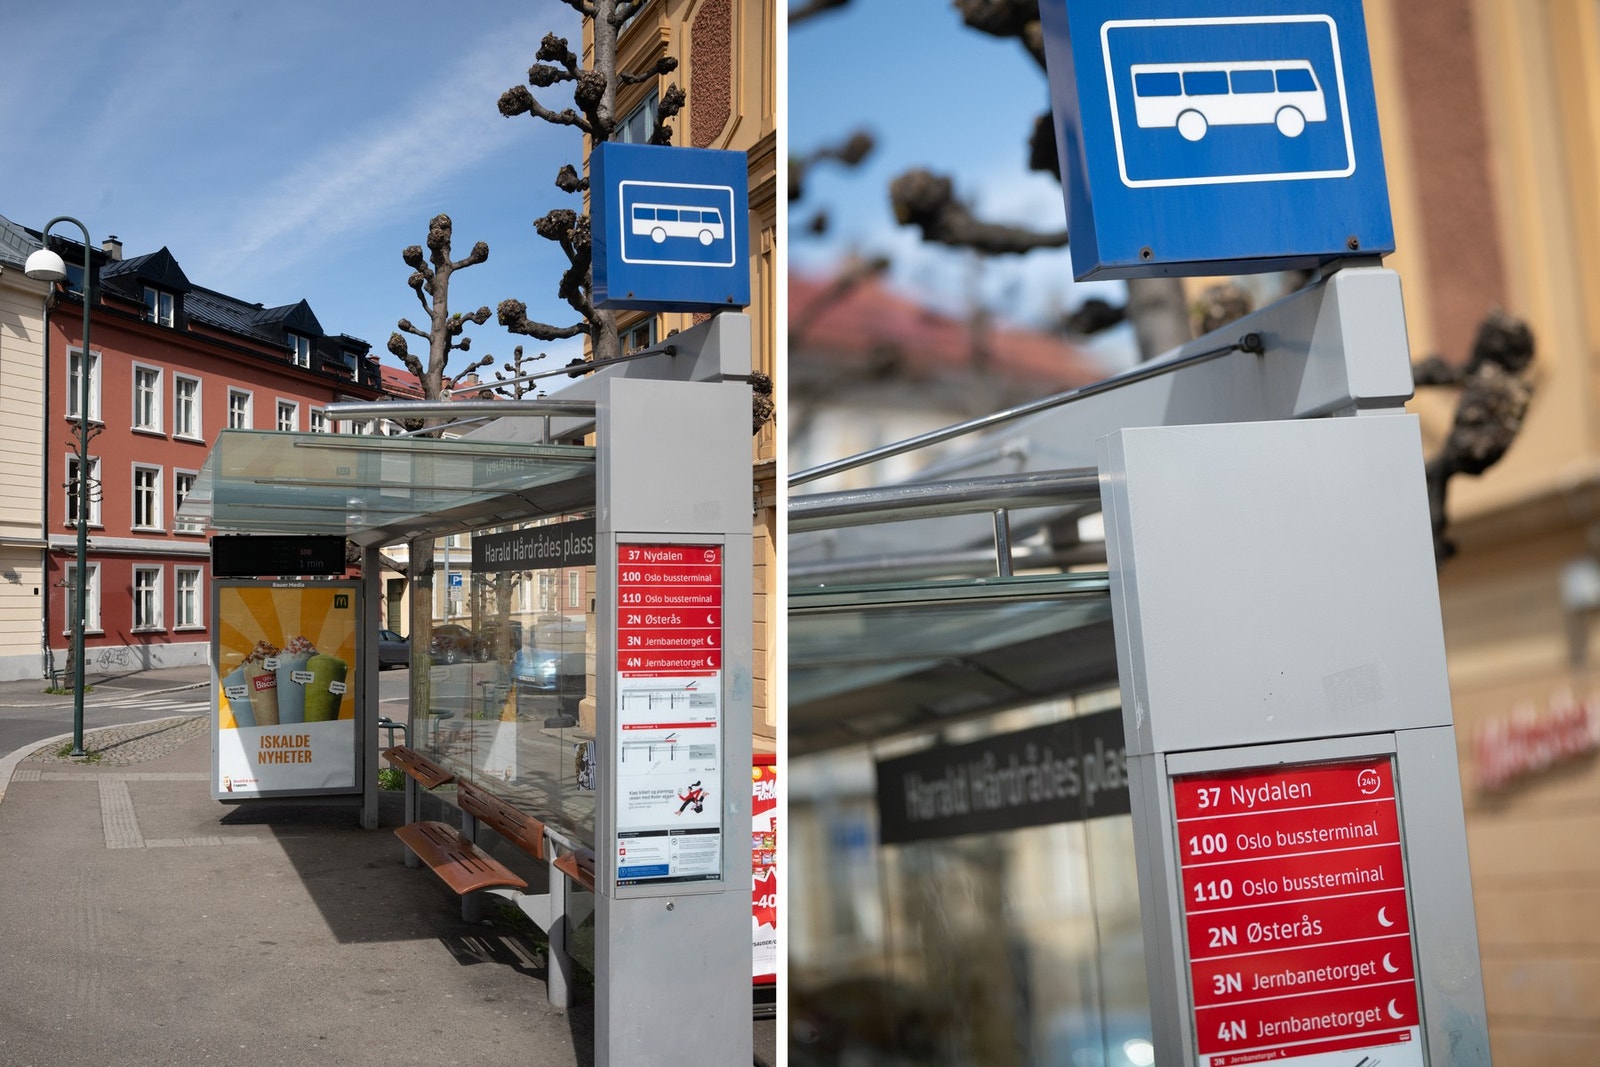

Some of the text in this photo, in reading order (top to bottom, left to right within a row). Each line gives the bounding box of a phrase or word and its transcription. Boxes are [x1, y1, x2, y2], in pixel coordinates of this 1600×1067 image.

[485, 532, 594, 562] Harald Hårdrådes plass
[628, 550, 683, 563] 37 Nydalen
[307, 560, 324, 568] min
[453, 576, 461, 585] P
[622, 572, 712, 582] 100 Oslo bussterminal
[622, 593, 712, 603] 110 Oslo bussterminal
[627, 613, 681, 625] 2N Østerås
[627, 636, 704, 647] 3N Jernbanetorget
[627, 657, 704, 669] 4N Jernbanetorget
[260, 734, 310, 749] ISKALDE
[258, 750, 312, 764] NYHETER
[1196, 777, 1376, 808] 37 Nydalen 24h
[1188, 820, 1378, 856] 100 Oslo bussterminal
[1193, 865, 1384, 902] 110 Oslo bussterminal
[1208, 914, 1323, 948] 2N Østerås
[1213, 960, 1377, 995] 3N Jernbanetorget
[1217, 1006, 1382, 1042] 4N Jernbanetorget
[1214, 1050, 1277, 1066] 3N Jernbanetorget
